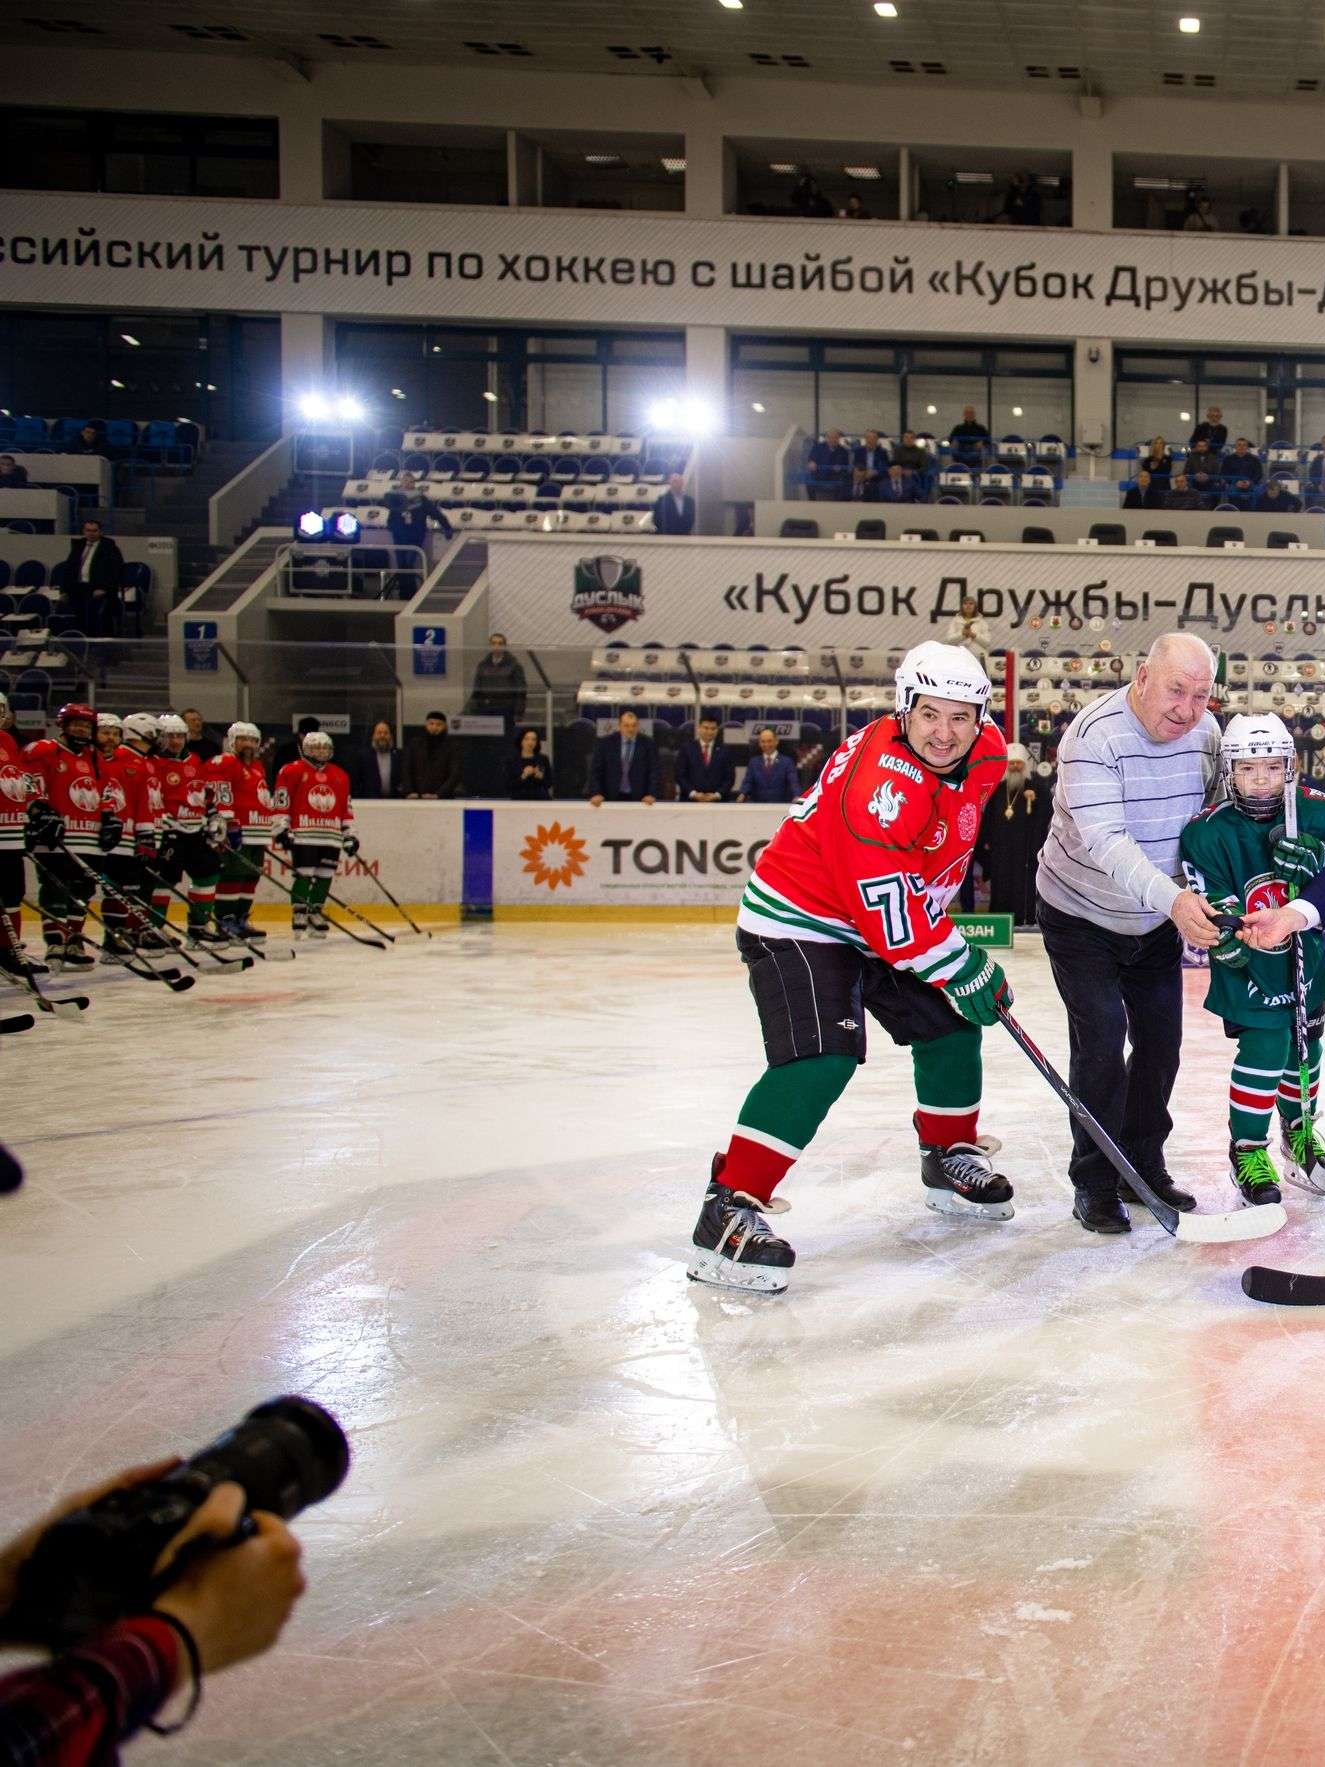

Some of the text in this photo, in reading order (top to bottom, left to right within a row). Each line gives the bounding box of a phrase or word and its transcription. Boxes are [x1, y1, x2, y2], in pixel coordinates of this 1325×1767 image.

[0, 228, 224, 271] сийский
[238, 241, 412, 287] турнир
[427, 252, 484, 281] по
[498, 256, 676, 288] хоккею
[691, 261, 716, 290] с
[731, 255, 914, 295] шайбой
[928, 259, 1095, 305] «Кубок
[723, 572, 918, 617] «Кубок
[197, 626, 206, 640] 1
[425, 629, 436, 643] 2
[946, 679, 972, 688] CCM
[878, 753, 924, 784] КАЗАНЬ
[957, 925, 994, 938] АЗАН
